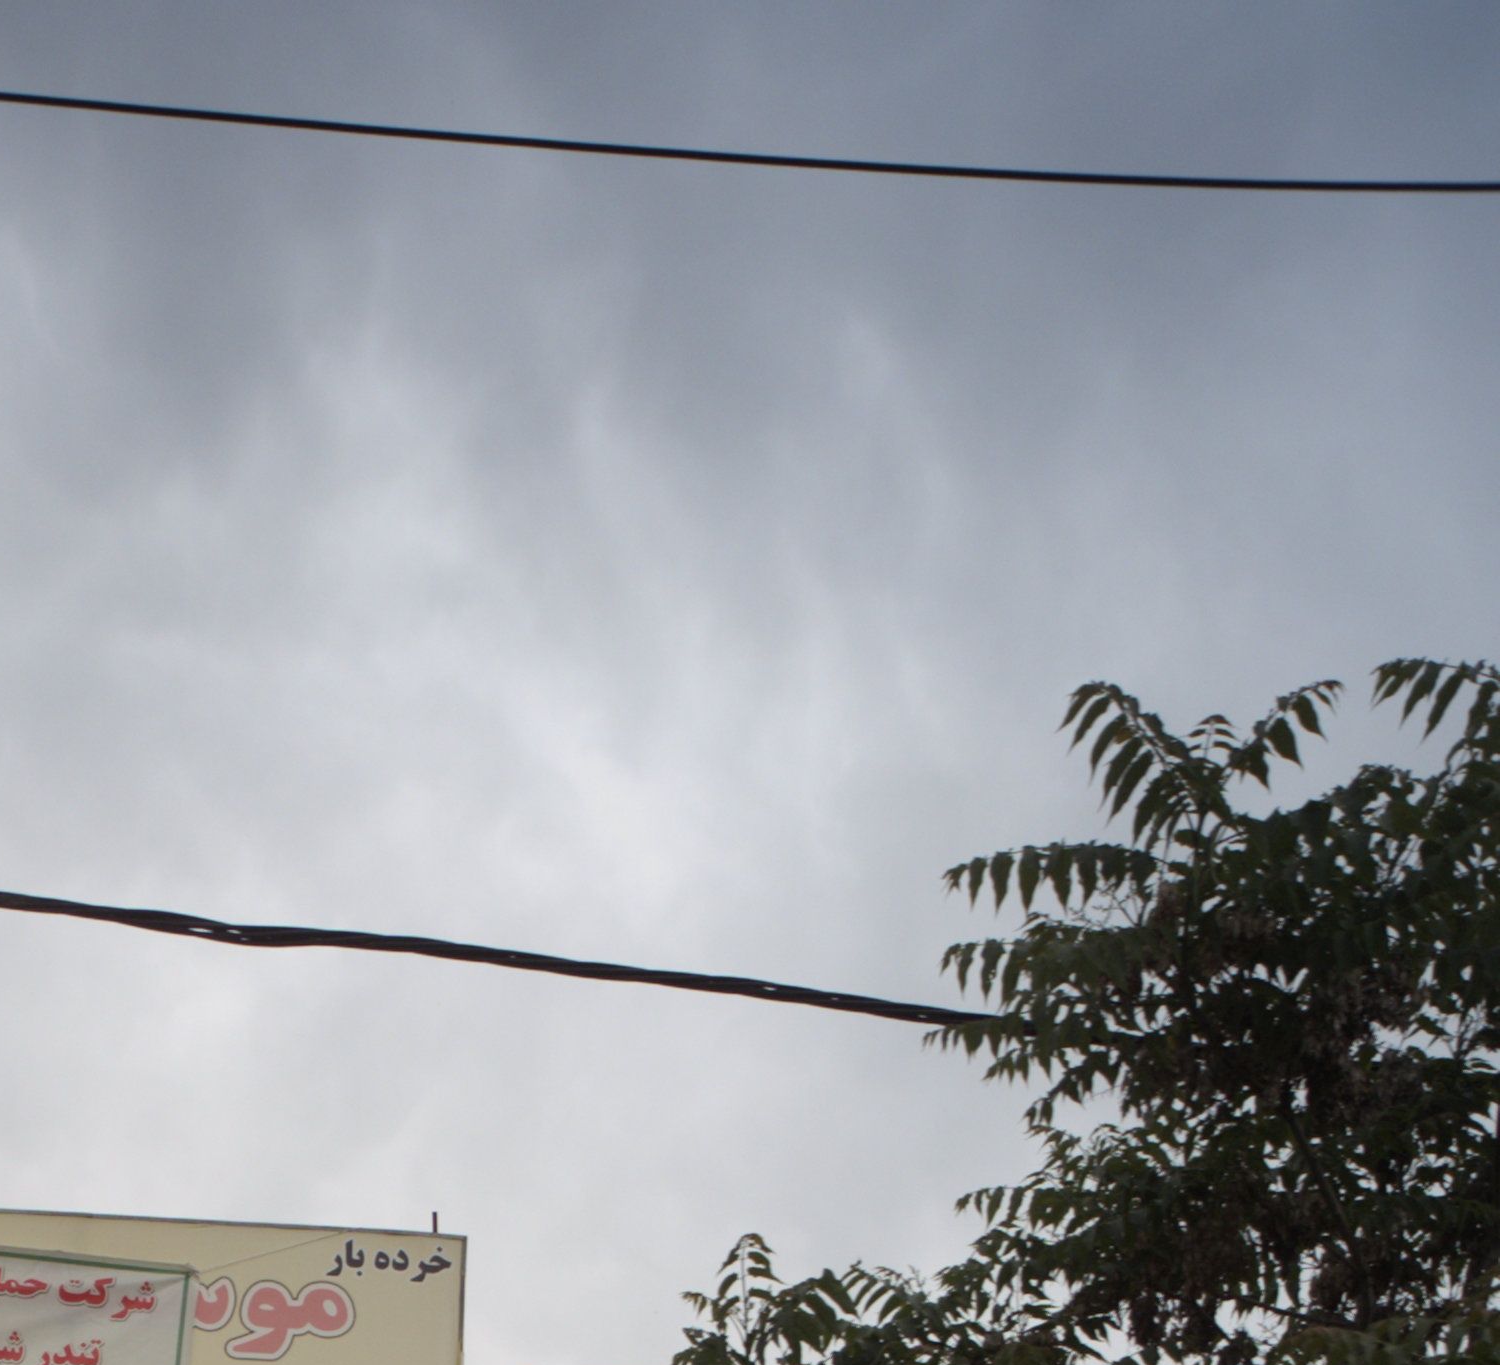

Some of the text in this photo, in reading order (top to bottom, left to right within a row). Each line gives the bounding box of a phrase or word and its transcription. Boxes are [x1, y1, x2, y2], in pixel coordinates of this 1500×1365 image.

[326, 1239, 452, 1282] خرده بار
[56, 1274, 155, 1321] شرکت
